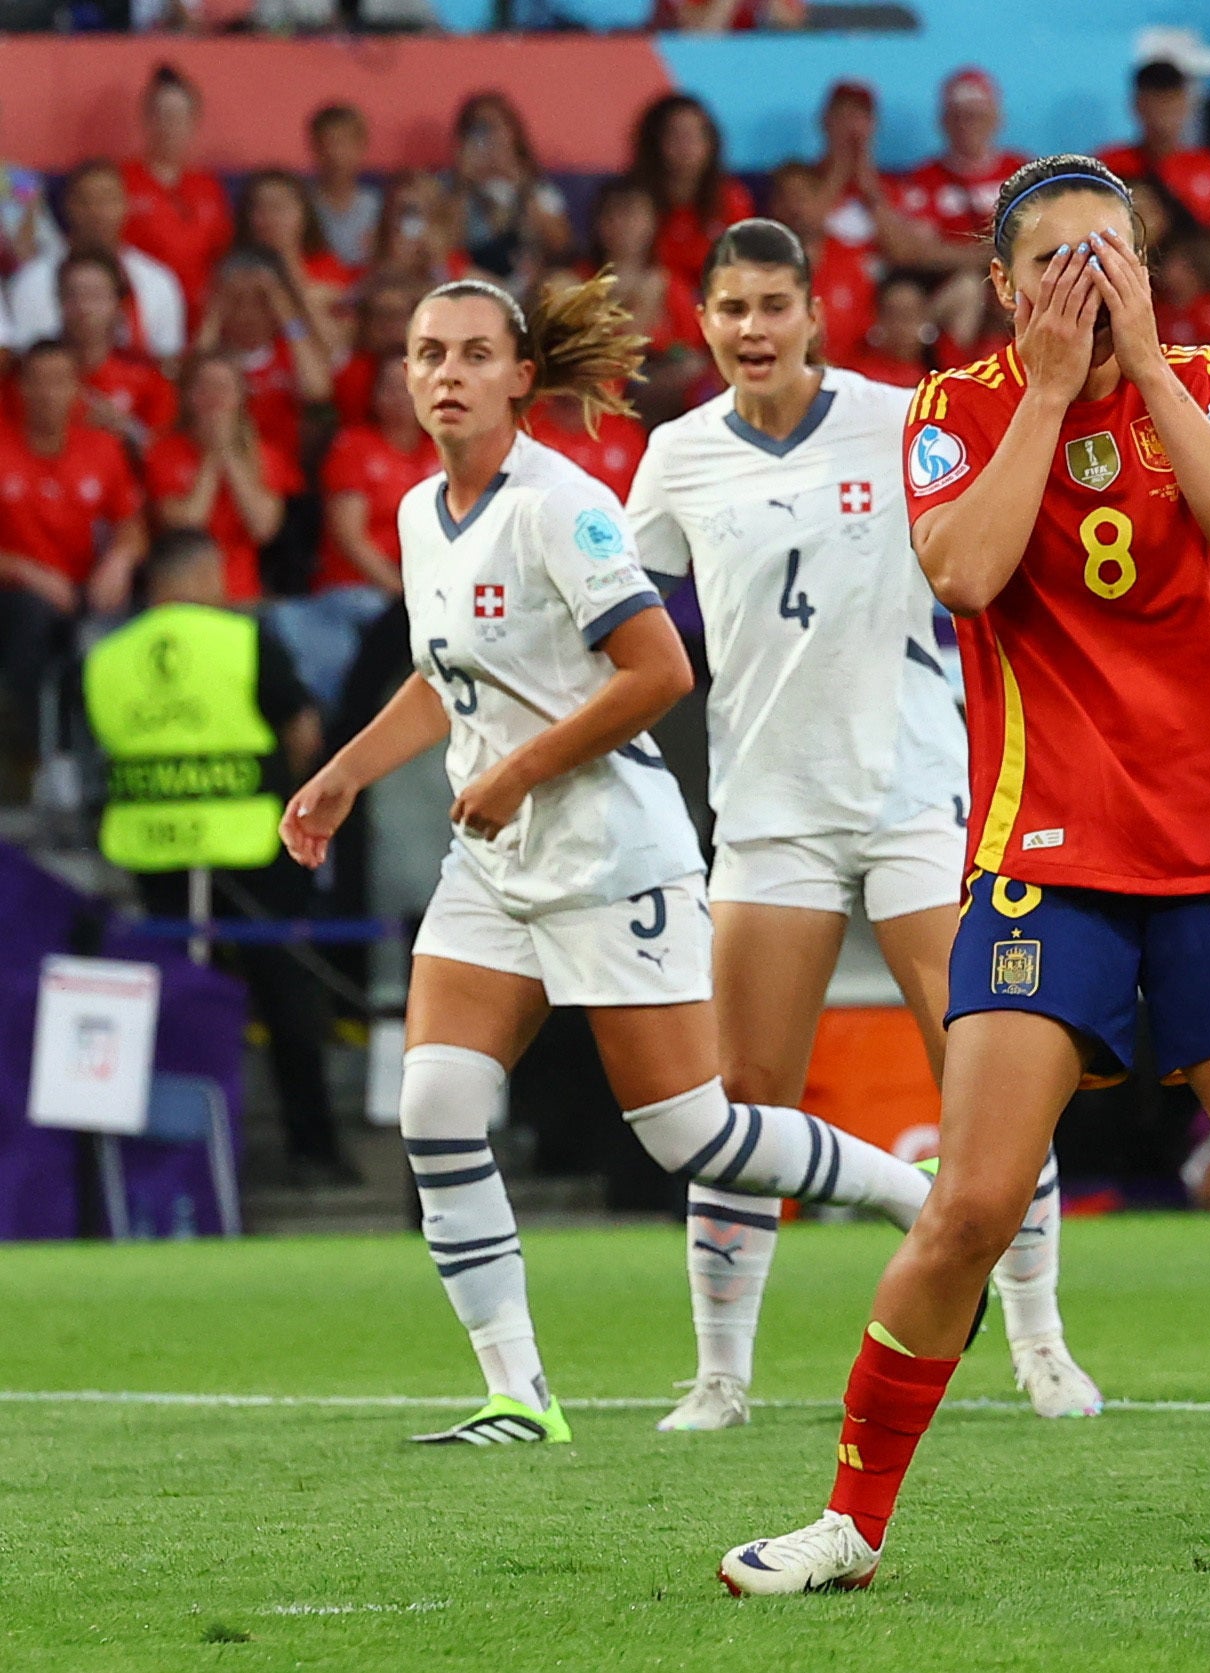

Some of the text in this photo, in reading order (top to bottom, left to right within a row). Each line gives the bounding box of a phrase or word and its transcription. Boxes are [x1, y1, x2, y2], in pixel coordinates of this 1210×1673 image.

[780, 548, 815, 629] 4
[1080, 506, 1136, 600] 8
[429, 638, 477, 715] 5
